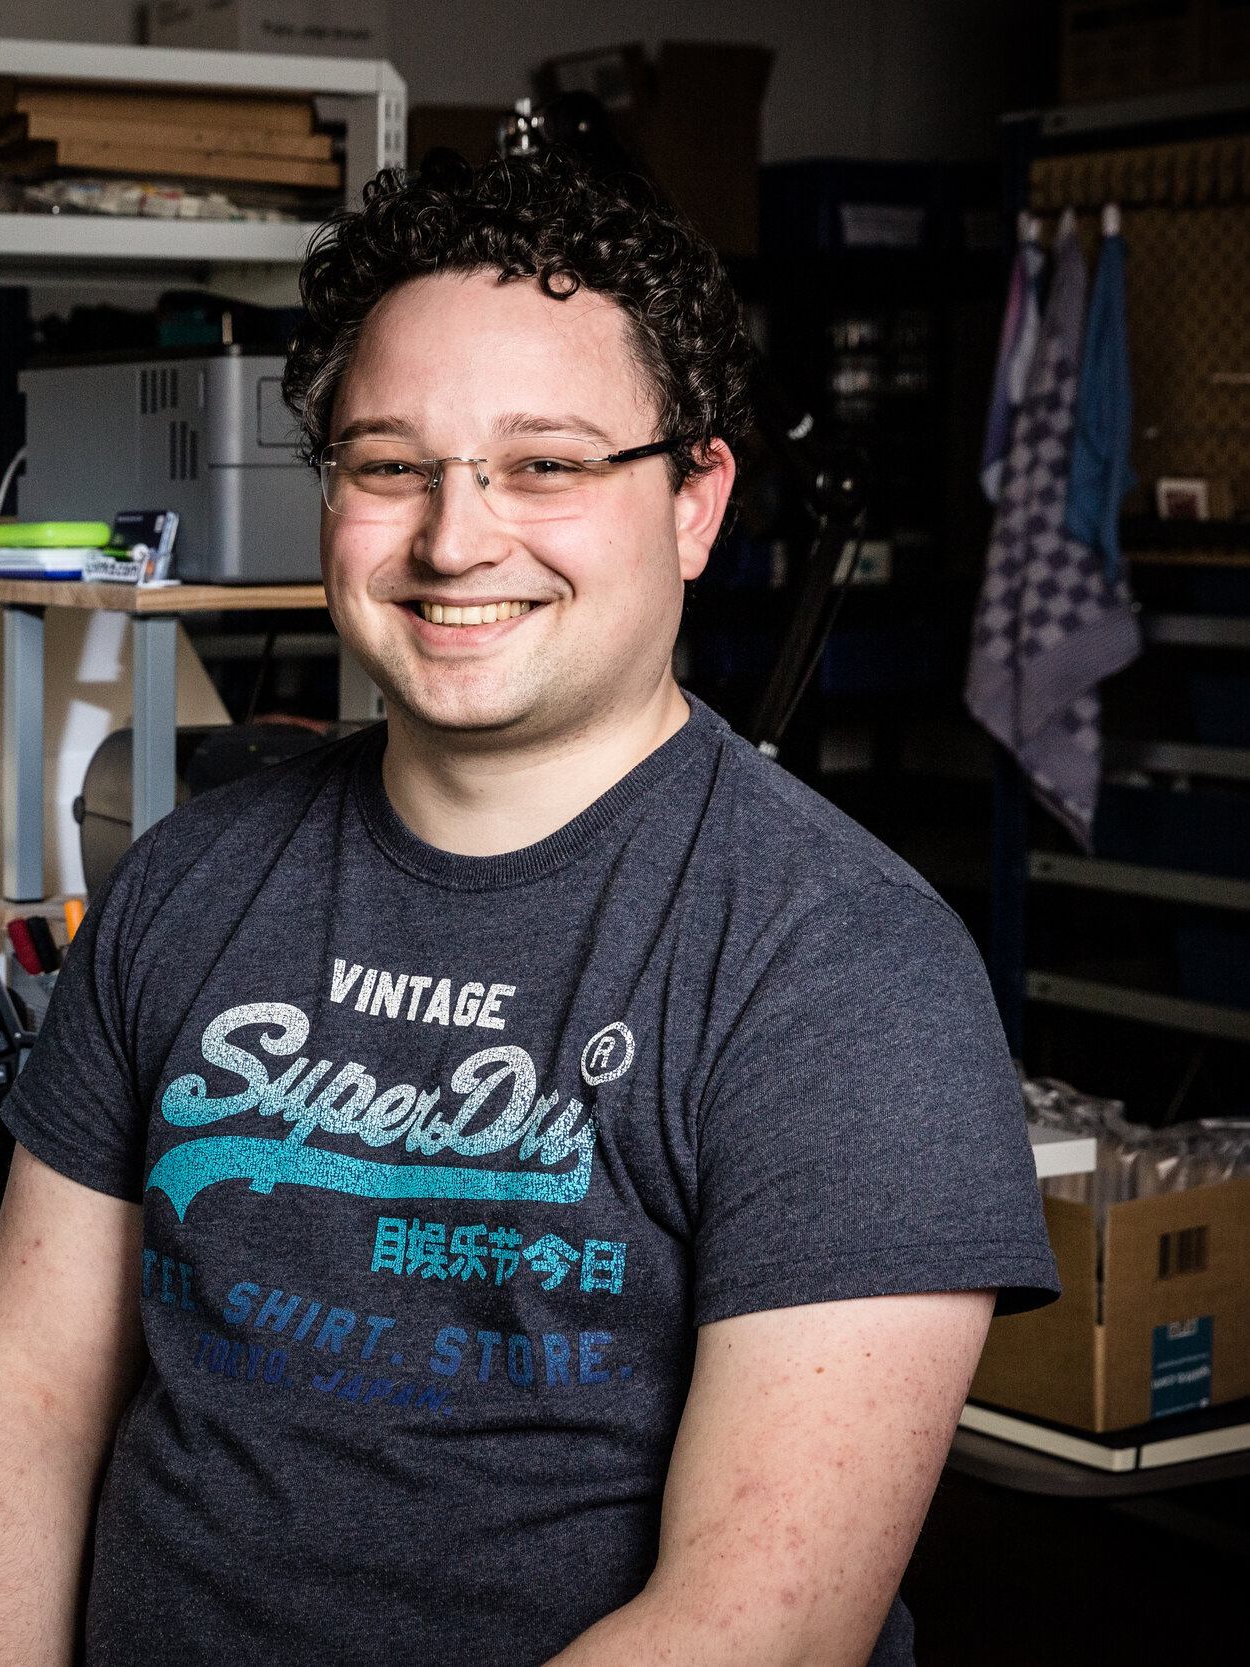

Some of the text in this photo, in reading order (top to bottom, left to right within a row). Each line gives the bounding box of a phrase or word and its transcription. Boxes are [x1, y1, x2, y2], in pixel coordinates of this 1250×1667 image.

[330, 958, 516, 1030] VINTAGE
[371, 1216, 627, 1294] 目娱乐节今日
[223, 1281, 403, 1364] SHIRT.
[430, 1326, 632, 1387] STORE.
[311, 1369, 453, 1416] JAPAN.
